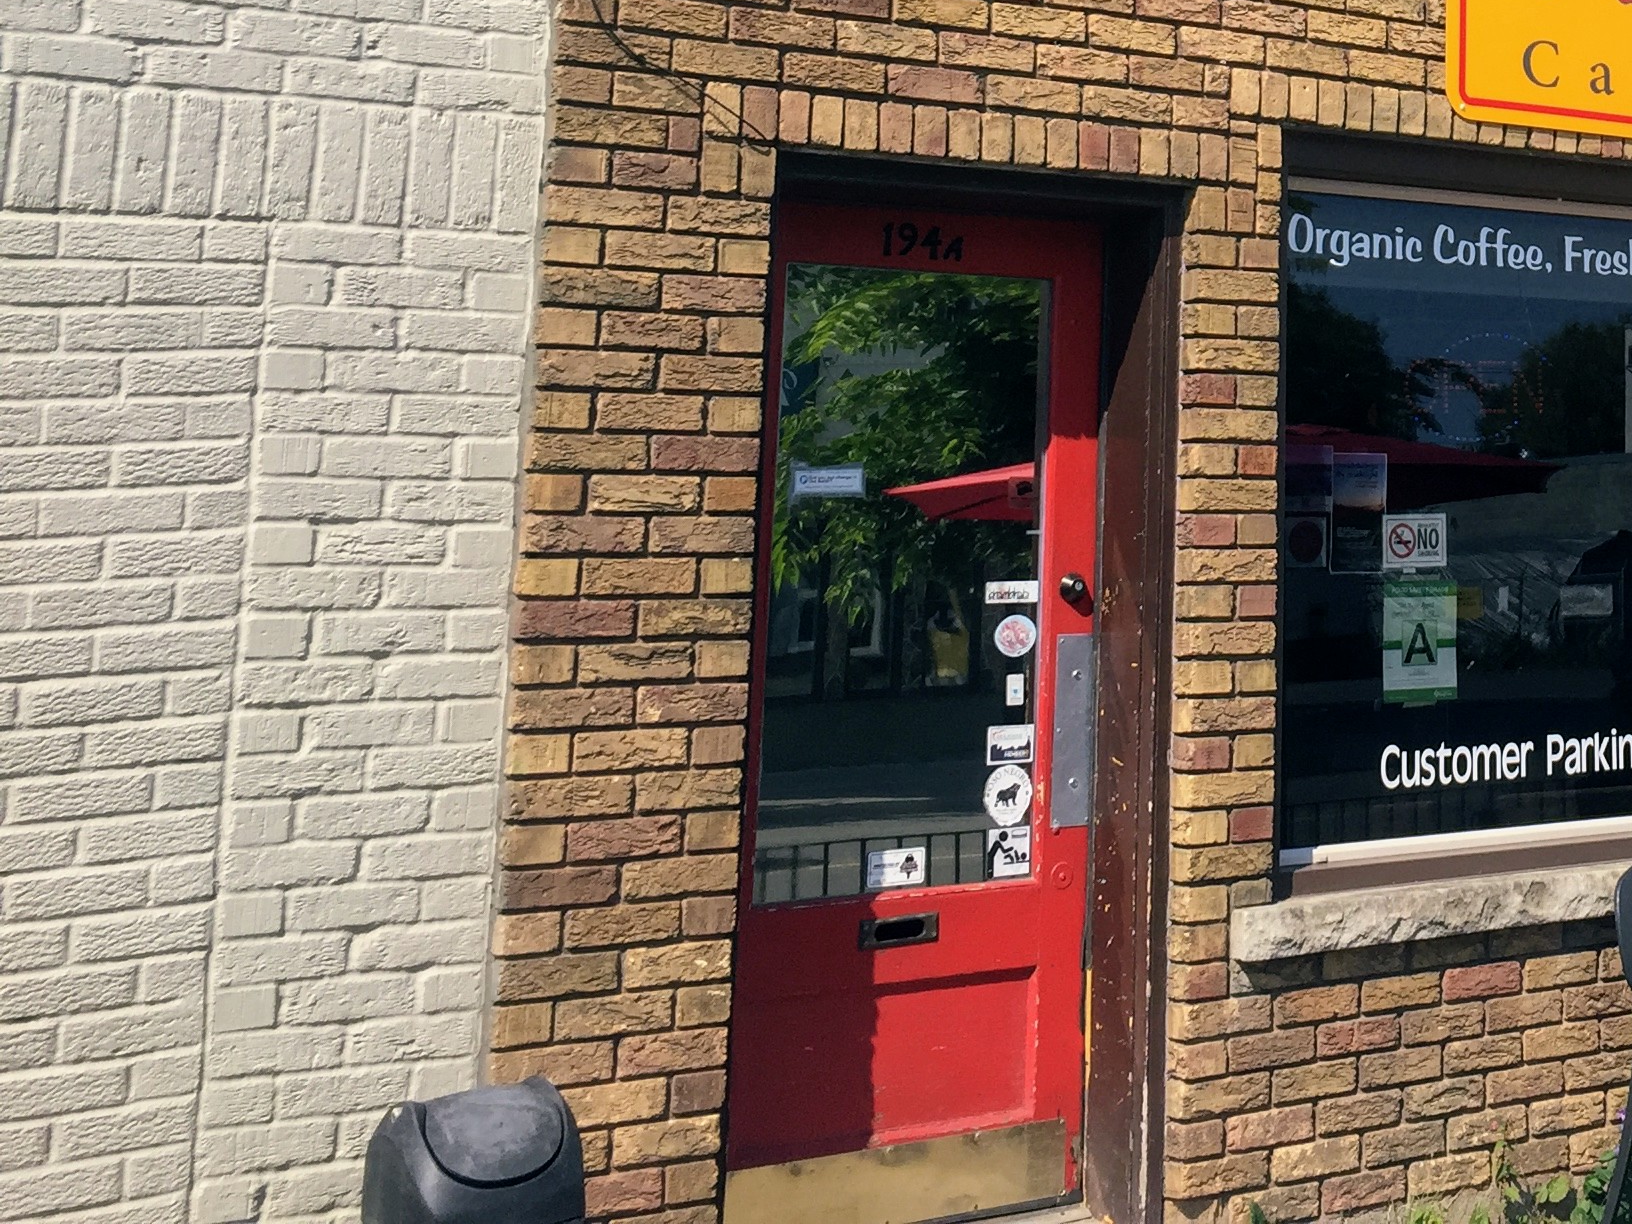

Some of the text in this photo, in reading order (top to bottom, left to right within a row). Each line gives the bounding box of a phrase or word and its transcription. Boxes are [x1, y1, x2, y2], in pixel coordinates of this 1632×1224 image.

[1288, 213, 1423, 266] Organic
[1433, 224, 1553, 273] Coffee,
[1417, 527, 1440, 549] NO
[1403, 622, 1436, 664] A
[1380, 739, 1535, 789] Customer
